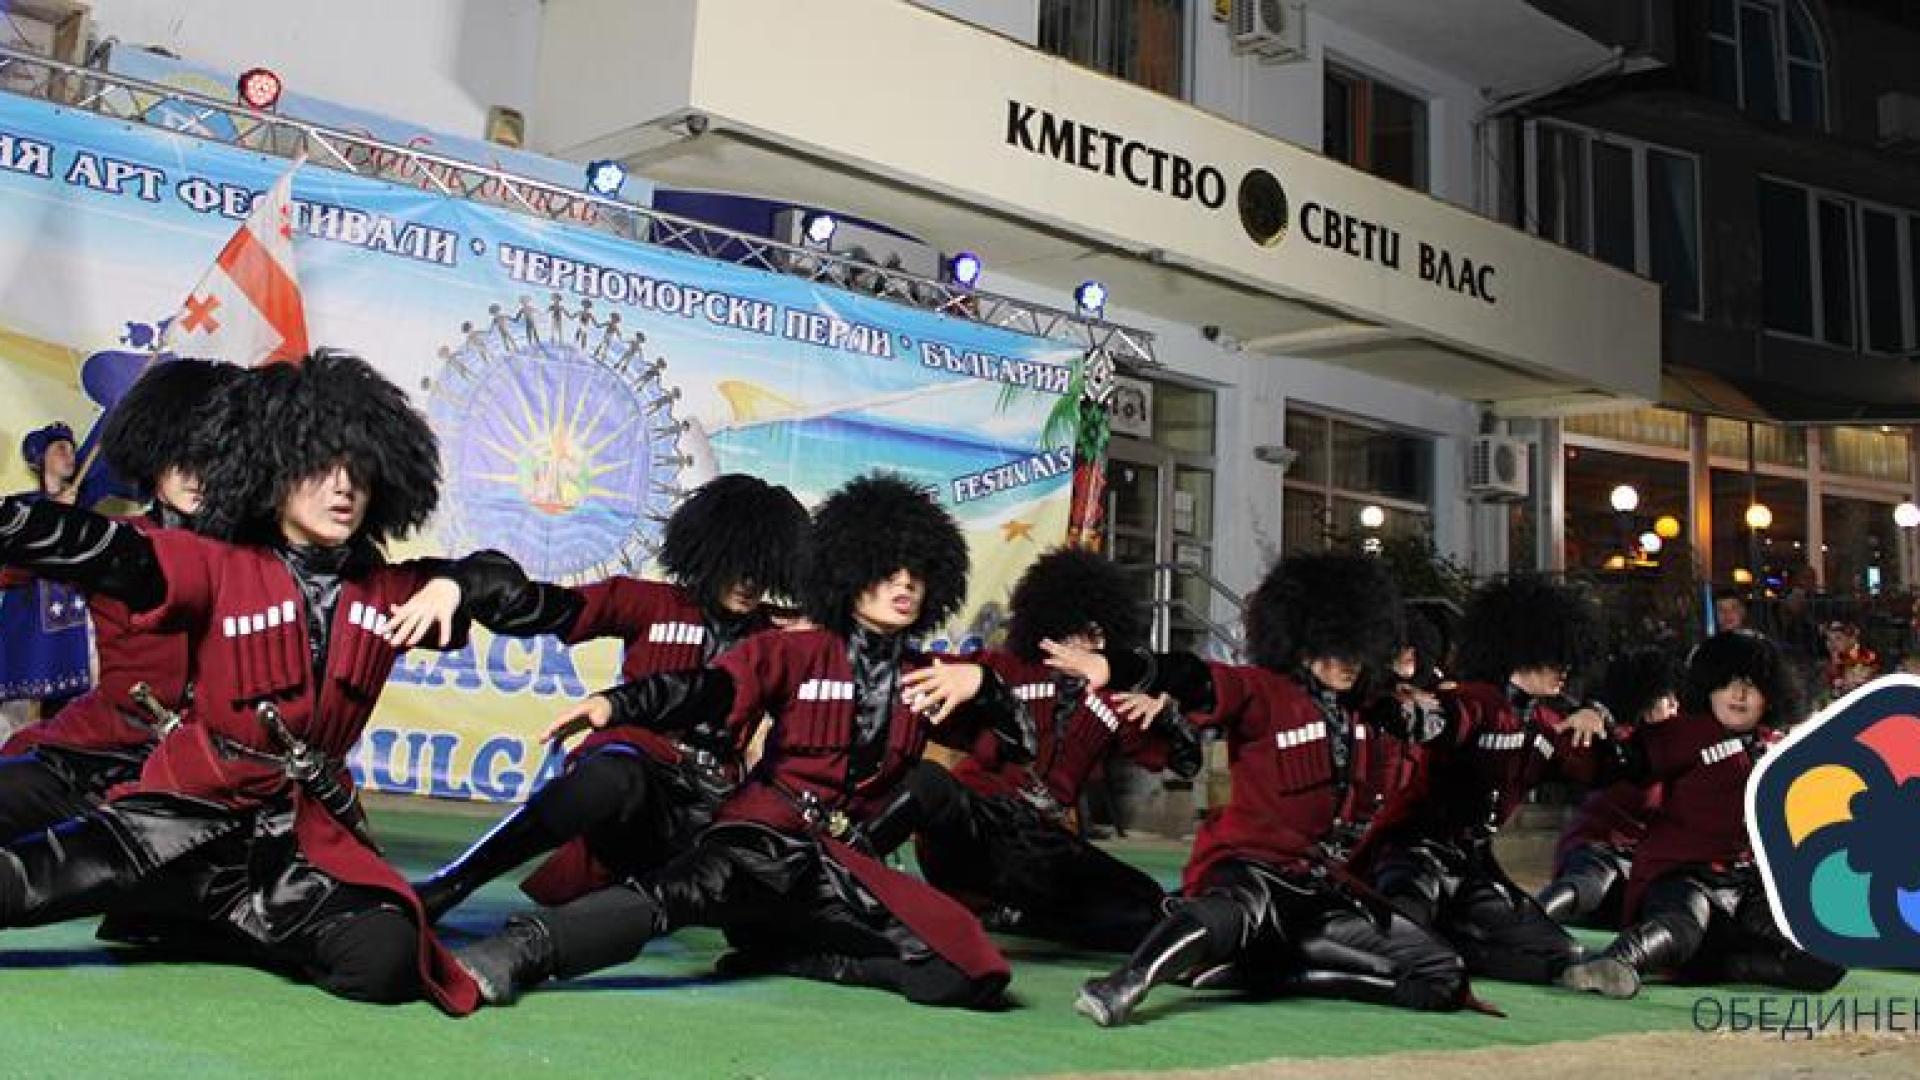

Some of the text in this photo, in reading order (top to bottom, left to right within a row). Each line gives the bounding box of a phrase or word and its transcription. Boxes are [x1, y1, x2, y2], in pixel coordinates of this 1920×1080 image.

[1006, 100, 1227, 209] КМЕТСТВО
[1418, 242, 1498, 304] ВЛАС
[65, 151, 166, 202] АРТ
[498, 242, 776, 336] ЧЕРНОМОРСКИ
[782, 305, 894, 359] ПЕРЛИ
[918, 340, 1072, 394] БЪЛГАРИЯ
[952, 445, 1075, 502] FESTIVALS
[388, 624, 588, 699] LACK
